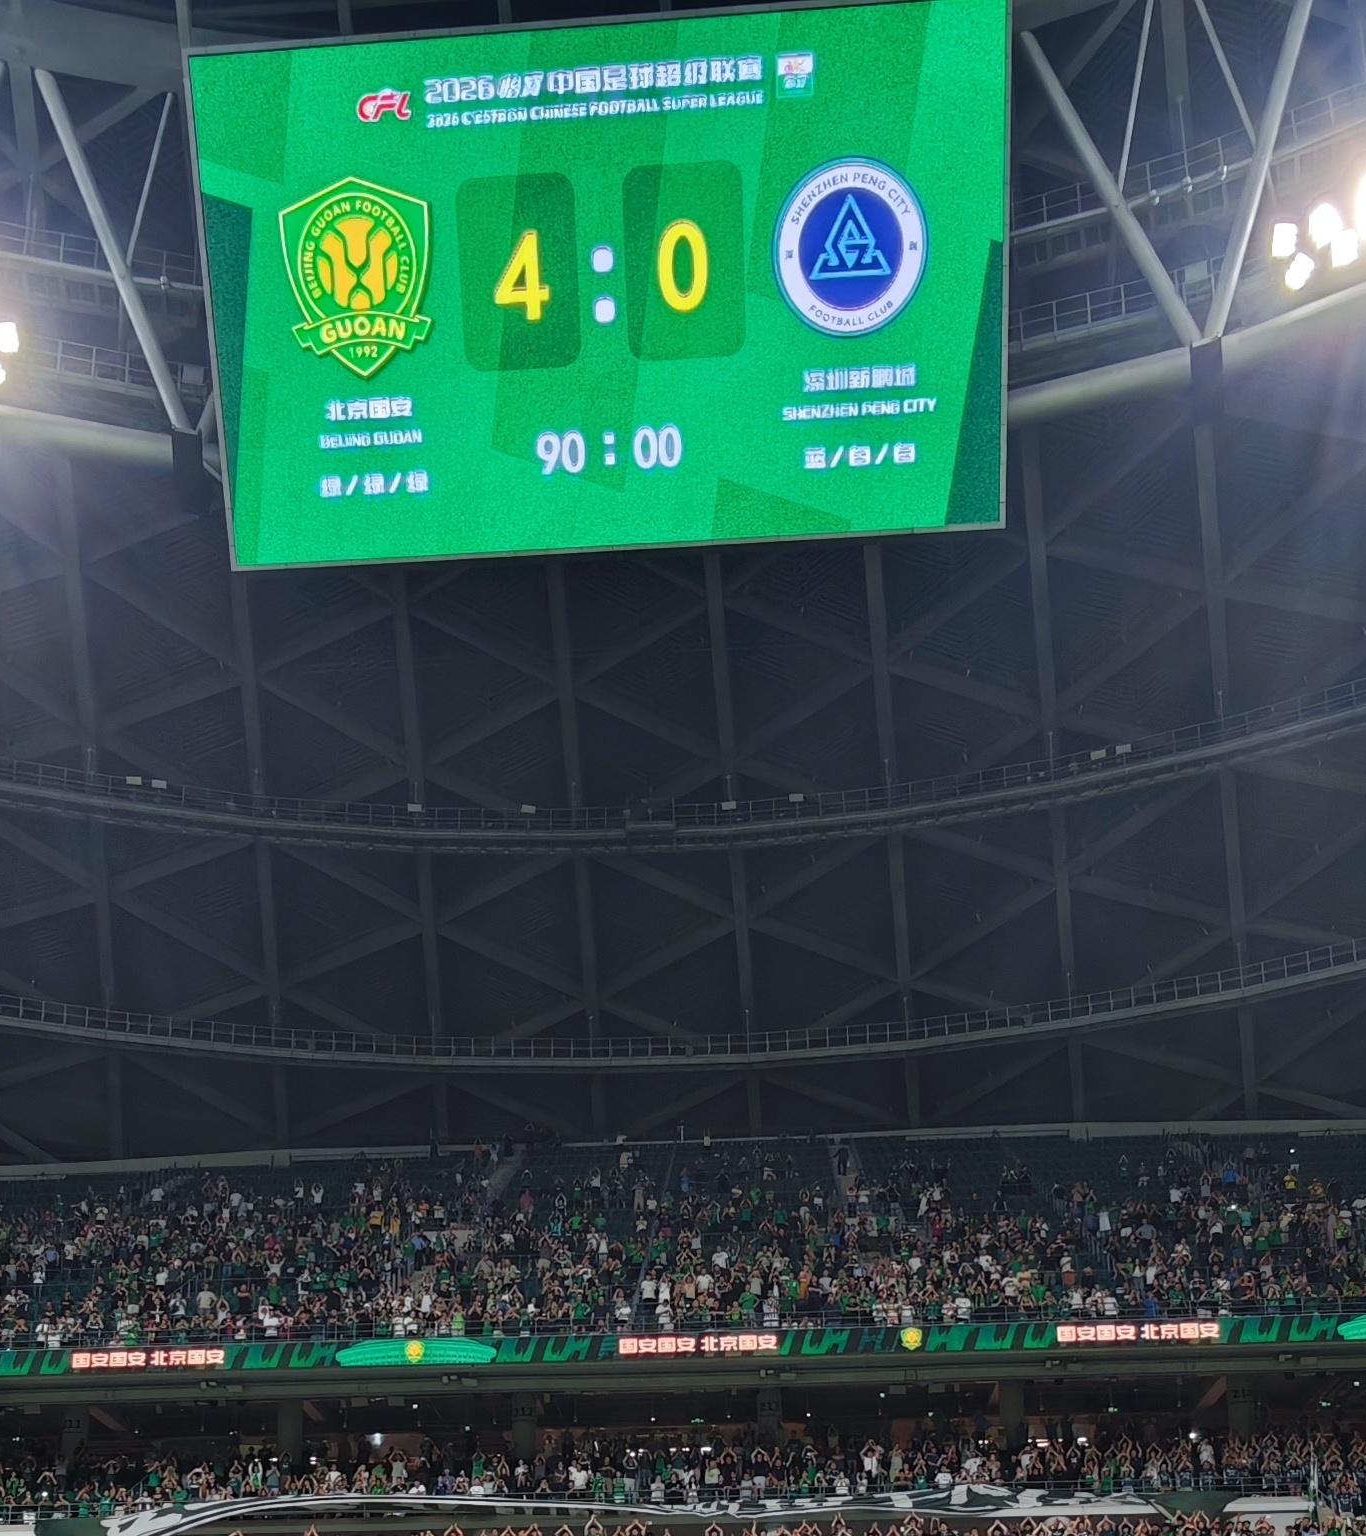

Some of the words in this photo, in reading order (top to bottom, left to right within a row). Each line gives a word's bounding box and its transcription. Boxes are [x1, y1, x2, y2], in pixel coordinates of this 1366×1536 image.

[530, 102, 587, 121] CHINESE
[589, 98, 661, 117] FOOTBALL
[662, 94, 708, 111] SUPER
[710, 89, 764, 108] LEAGUE
[790, 172, 849, 226] SHENZHEN
[852, 172, 887, 192] PENG
[887, 188, 911, 217] CITY
[310, 200, 352, 238] GUOAN
[355, 200, 407, 251] FOOTBALL
[304, 241, 323, 300] BEIJING
[395, 255, 411, 295] CLUB
[494, 229, 550, 321] 4
[658, 219, 709, 312] 0
[807, 304, 865, 327] FOOTBALL
[867, 300, 894, 321] CLUB
[319, 316, 406, 344] GUOAN
[348, 345, 379, 358] 1992
[802, 363, 917, 393] 深圳新鹏城
[325, 396, 413, 421] 北京国安
[782, 402, 859, 421] SHENZHEN
[902, 397, 937, 413] CITY
[618, 1337, 696, 1355] 国安国安
[700, 1334, 779, 1351] 北京国安
[1056, 1324, 1136, 1342] 国安国安
[1140, 1322, 1220, 1340] 北京国安
[71, 1352, 147, 1369] 国安国安
[149, 1349, 225, 1366] 北京国安
